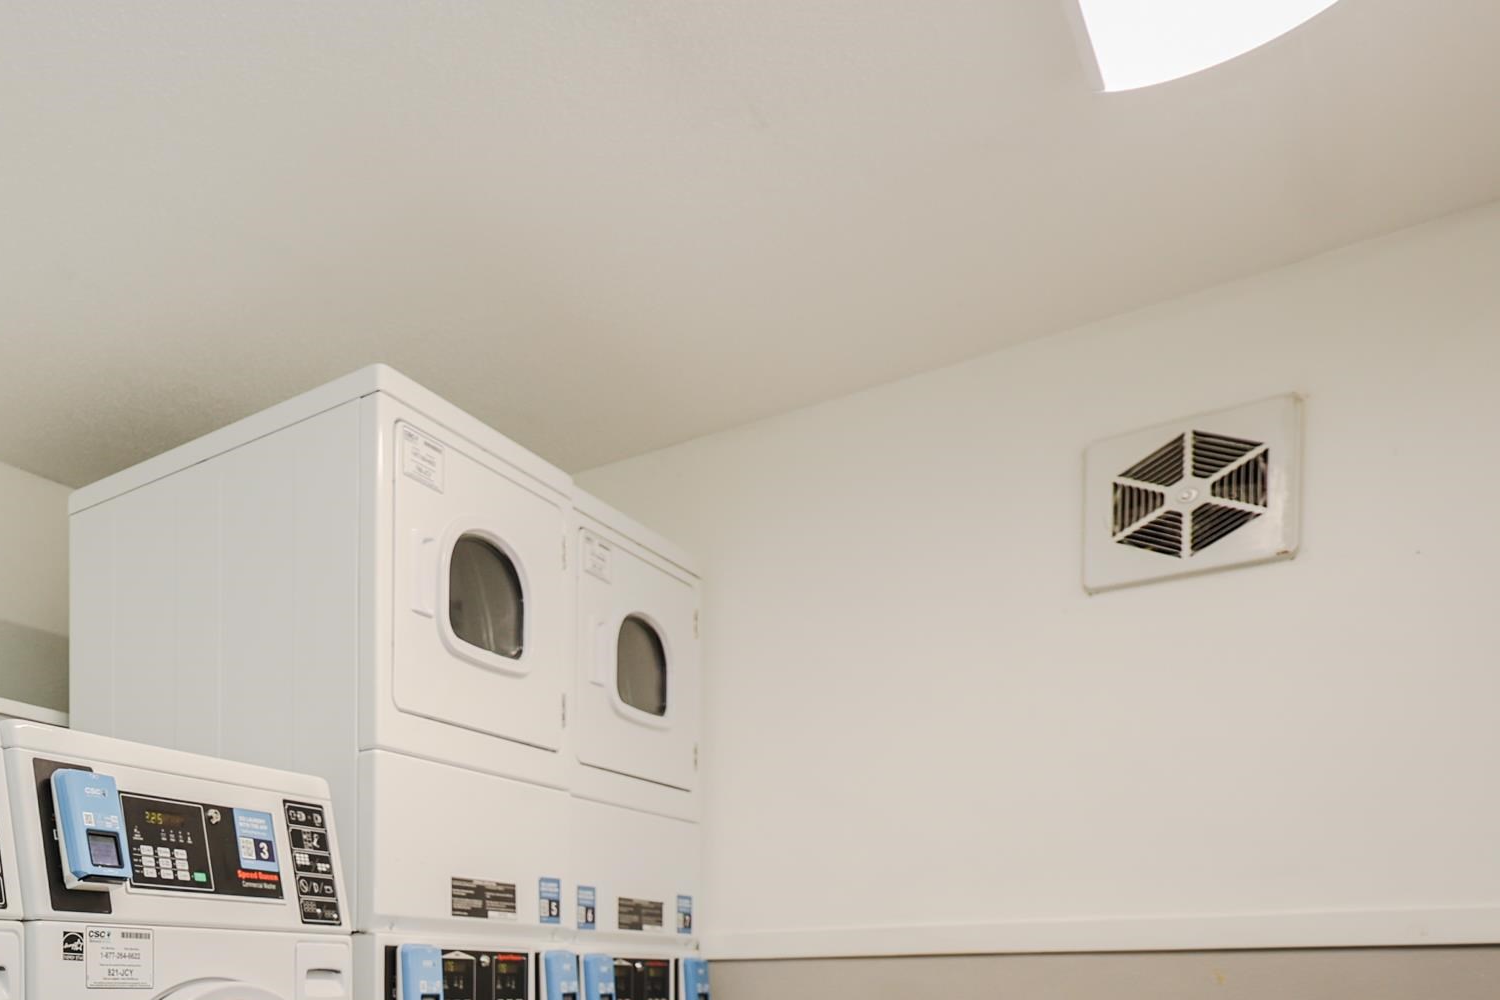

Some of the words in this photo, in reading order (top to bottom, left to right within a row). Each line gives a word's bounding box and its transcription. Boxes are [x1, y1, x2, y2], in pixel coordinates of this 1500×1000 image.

[259, 842, 269, 860] 3
[551, 901, 558, 916] 5
[88, 930, 106, 938] CSC
